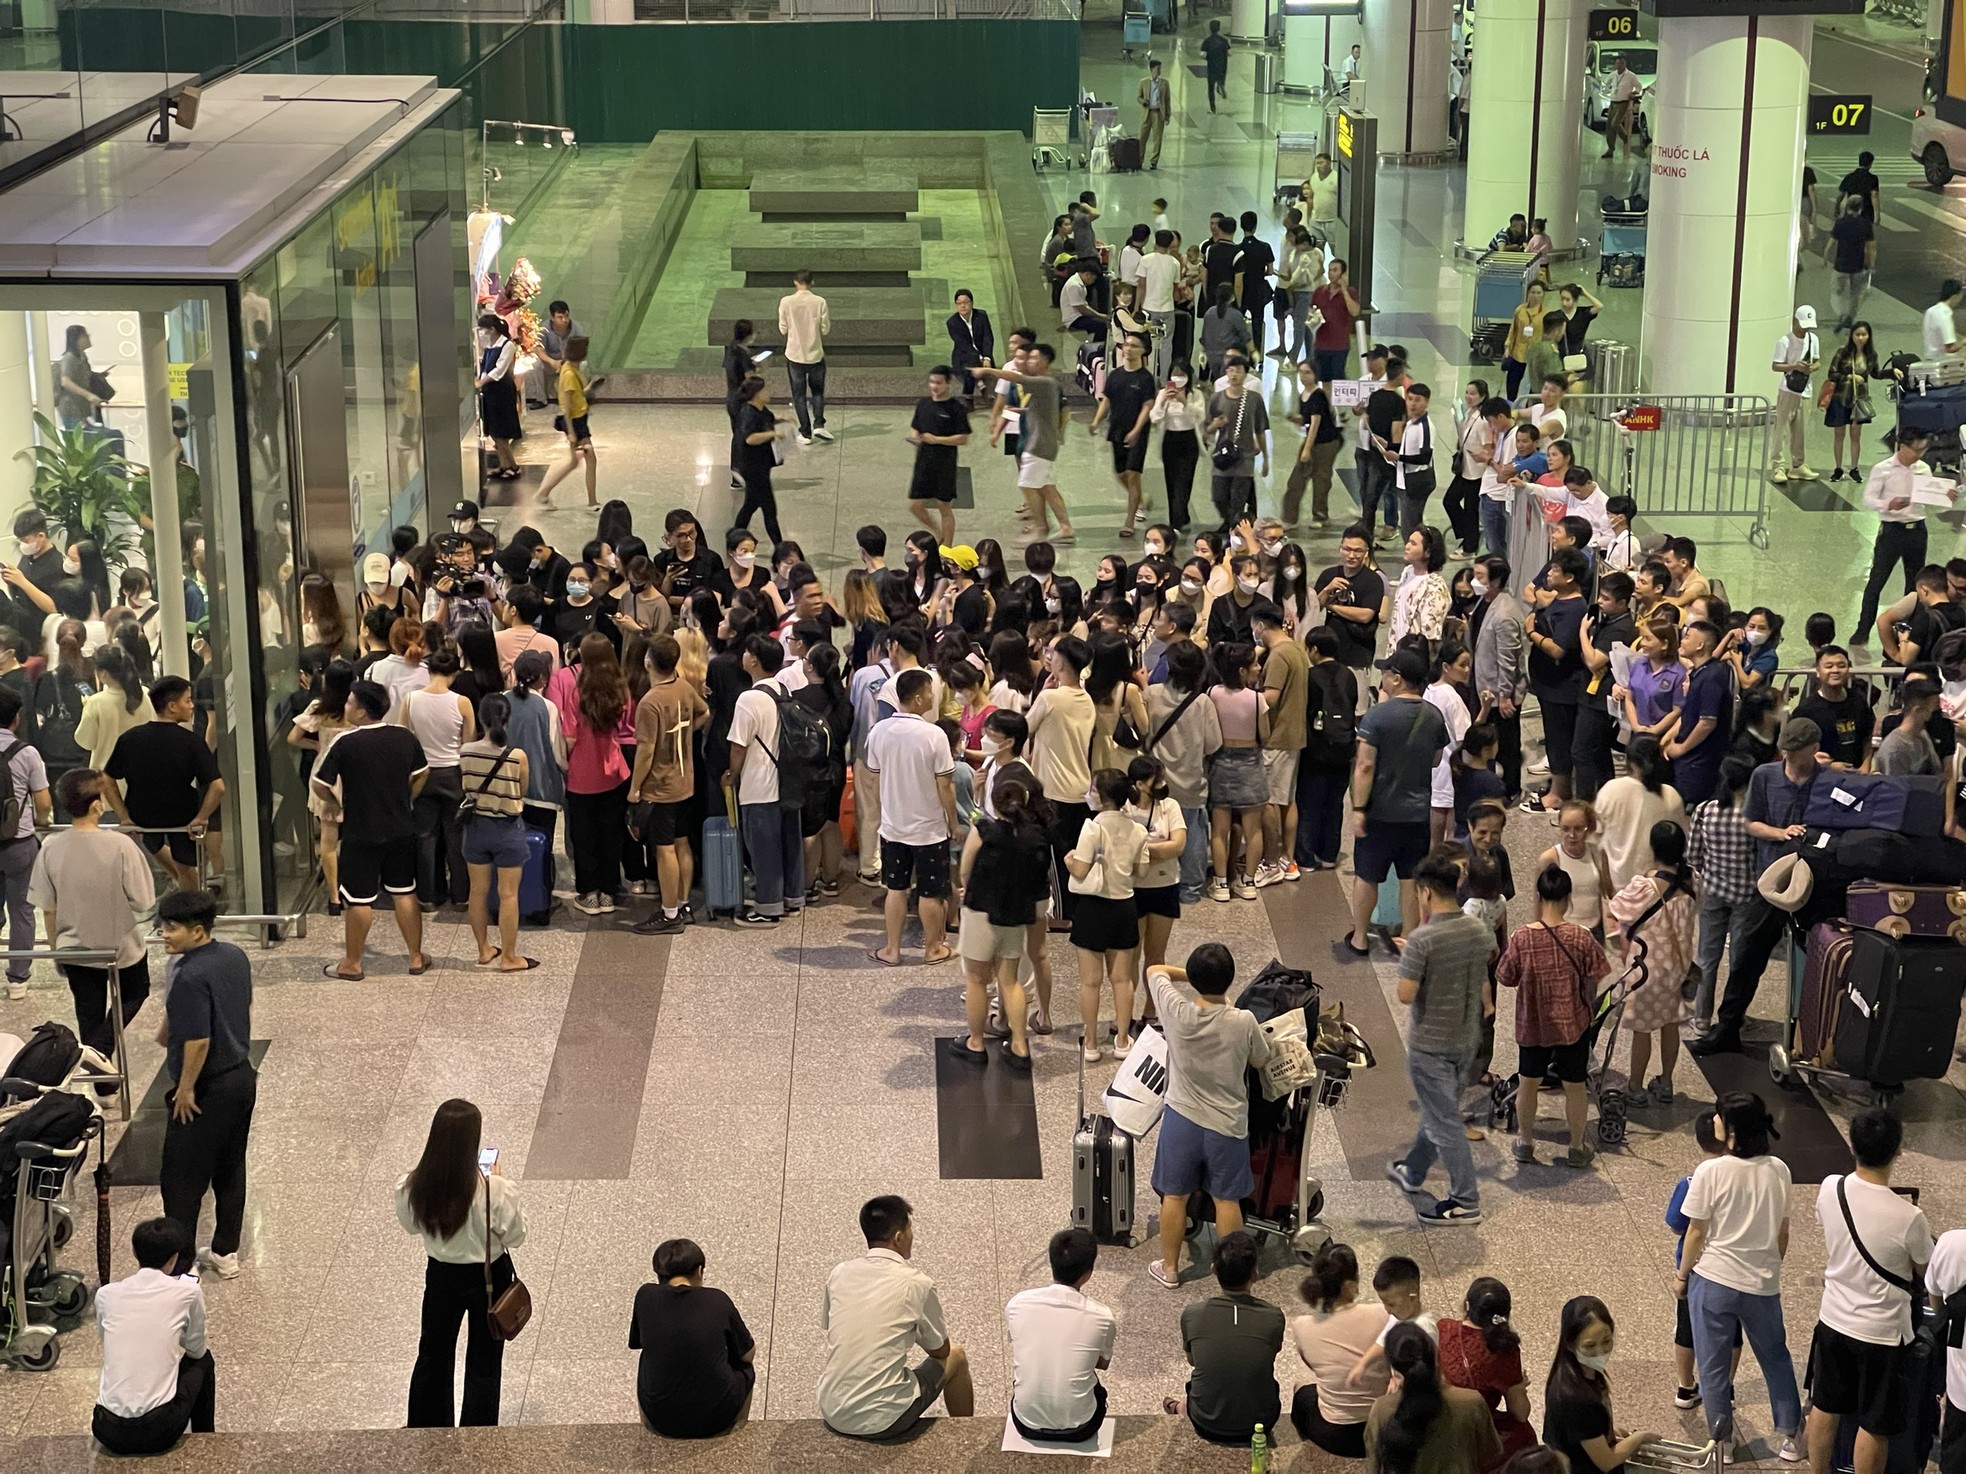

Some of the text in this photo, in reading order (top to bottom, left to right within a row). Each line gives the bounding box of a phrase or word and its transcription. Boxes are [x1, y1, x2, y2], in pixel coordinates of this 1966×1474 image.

[1608, 16, 1631, 33] 06
[1832, 104, 1864, 126] 07
[1816, 121, 1827, 130] 1F
[1658, 144, 1689, 160] THUỐC
[1693, 147, 1710, 161] LÁ
[1270, 1058, 1294, 1073] AIRSTAR
[1273, 1063, 1296, 1078] AVENUE
